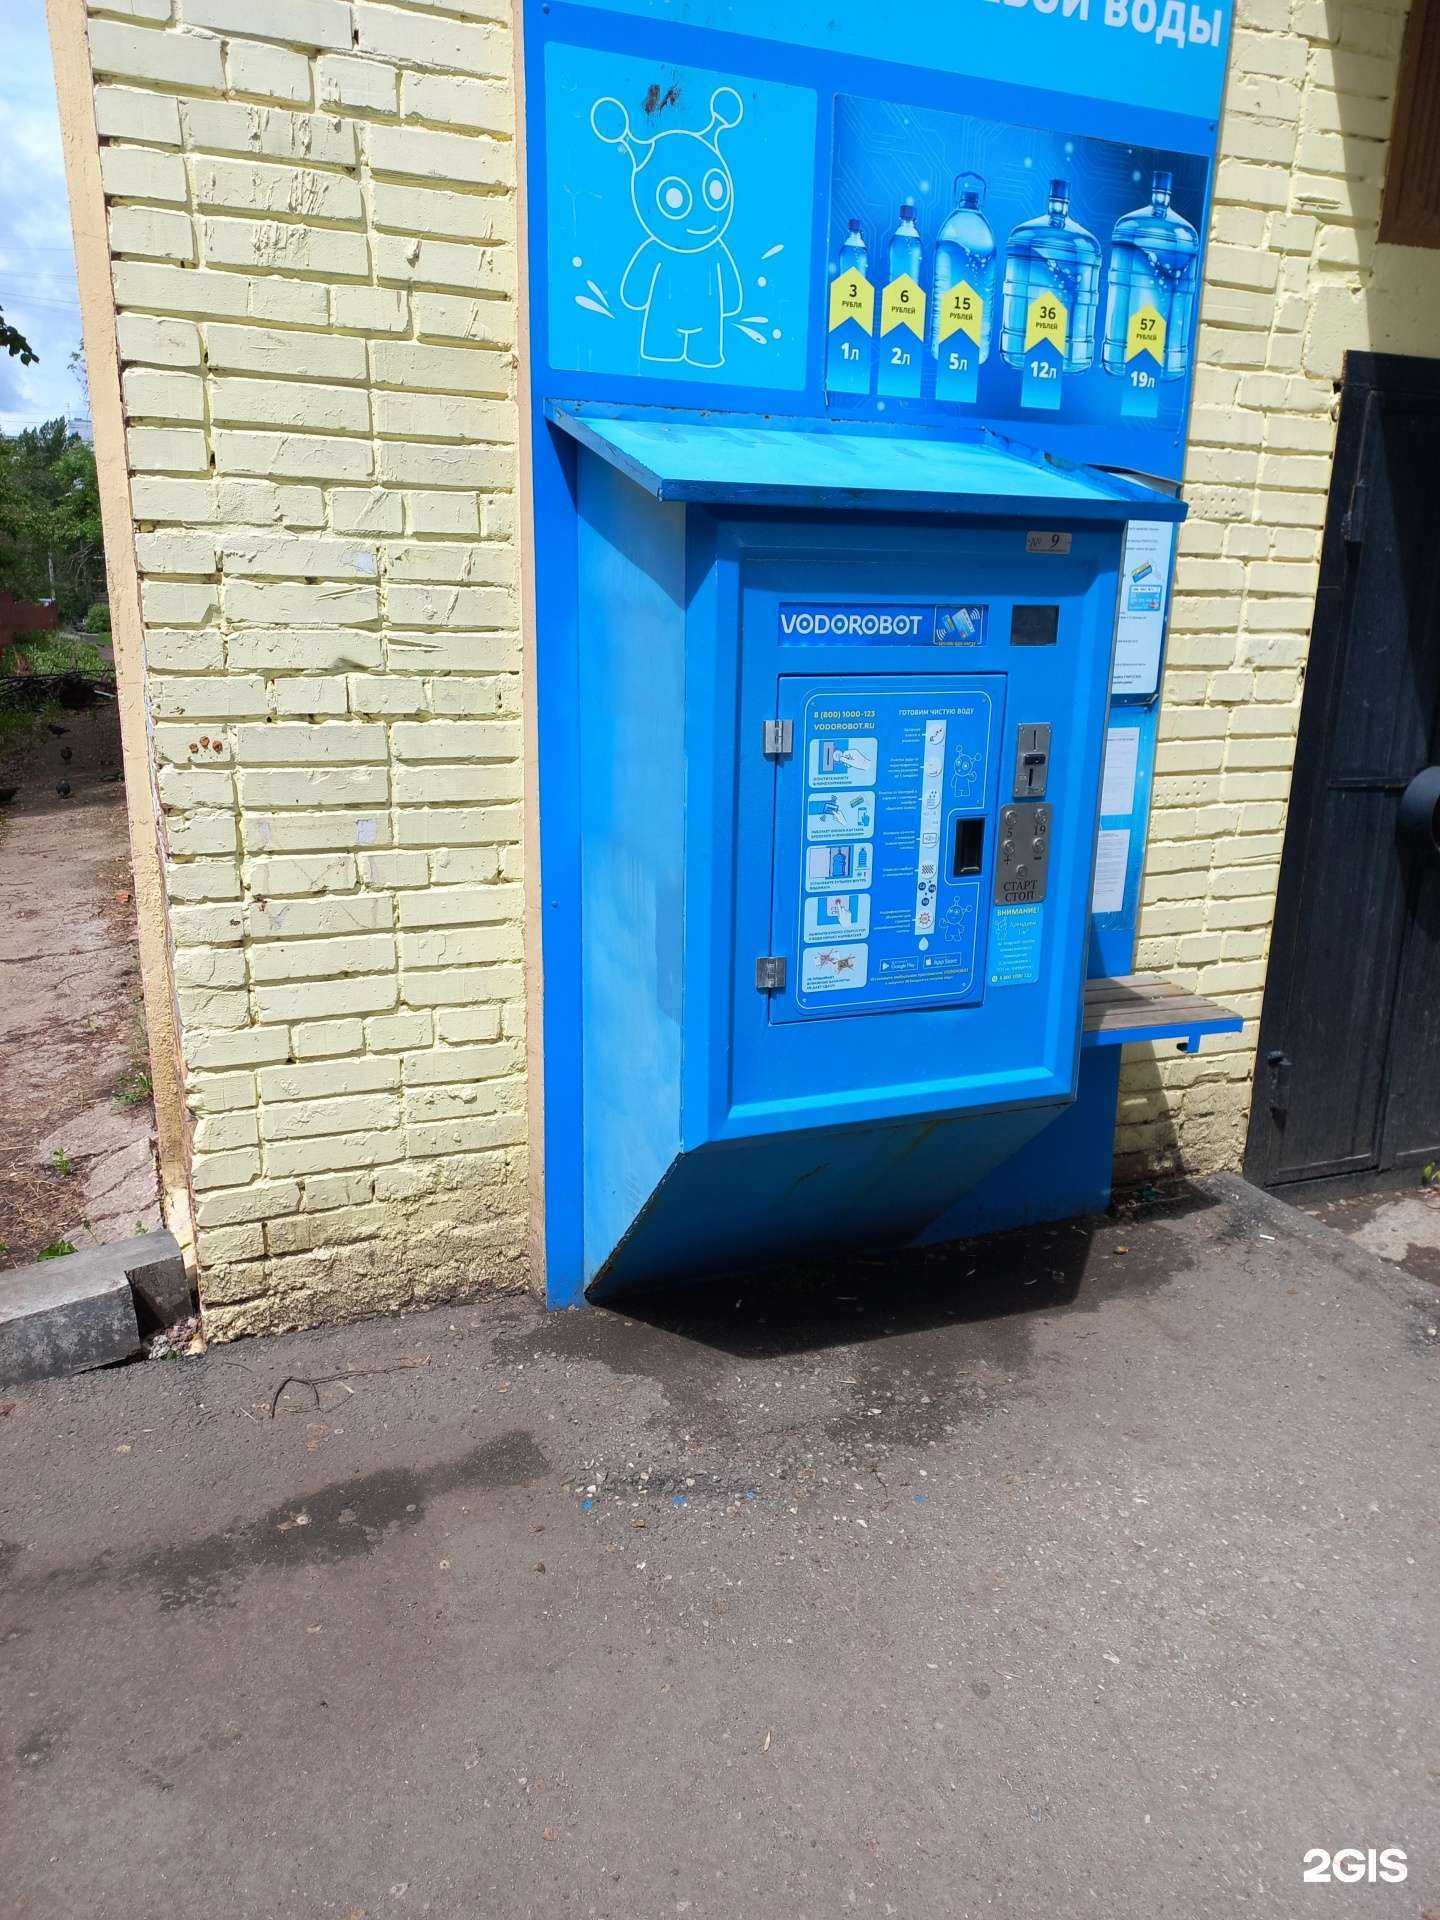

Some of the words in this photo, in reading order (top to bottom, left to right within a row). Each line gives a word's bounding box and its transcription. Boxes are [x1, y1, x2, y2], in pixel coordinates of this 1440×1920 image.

[1104, 0, 1222, 49] ВОДЫ
[849, 284, 858, 298] 3
[900, 289, 909, 303] 6
[841, 300, 862, 309] РУБЛЯ
[891, 305, 916, 315] РУБЛЕЙ
[954, 296, 971, 311] 15
[949, 312, 973, 321] РУБЛЕЙ
[1039, 306, 1056, 320] 36
[1140, 318, 1156, 332] 57
[780, 614, 922, 636] VODOROBOT
[899, 708, 929, 716] ГОТОВИМ
[929, 708, 956, 716] ЧИСТУЮ
[957, 707, 974, 715] ВОДУ
[814, 722, 875, 731] VODOROBOT.RU
[1003, 880, 1038, 892] СТАРТ
[1005, 891, 1034, 902] СТОП
